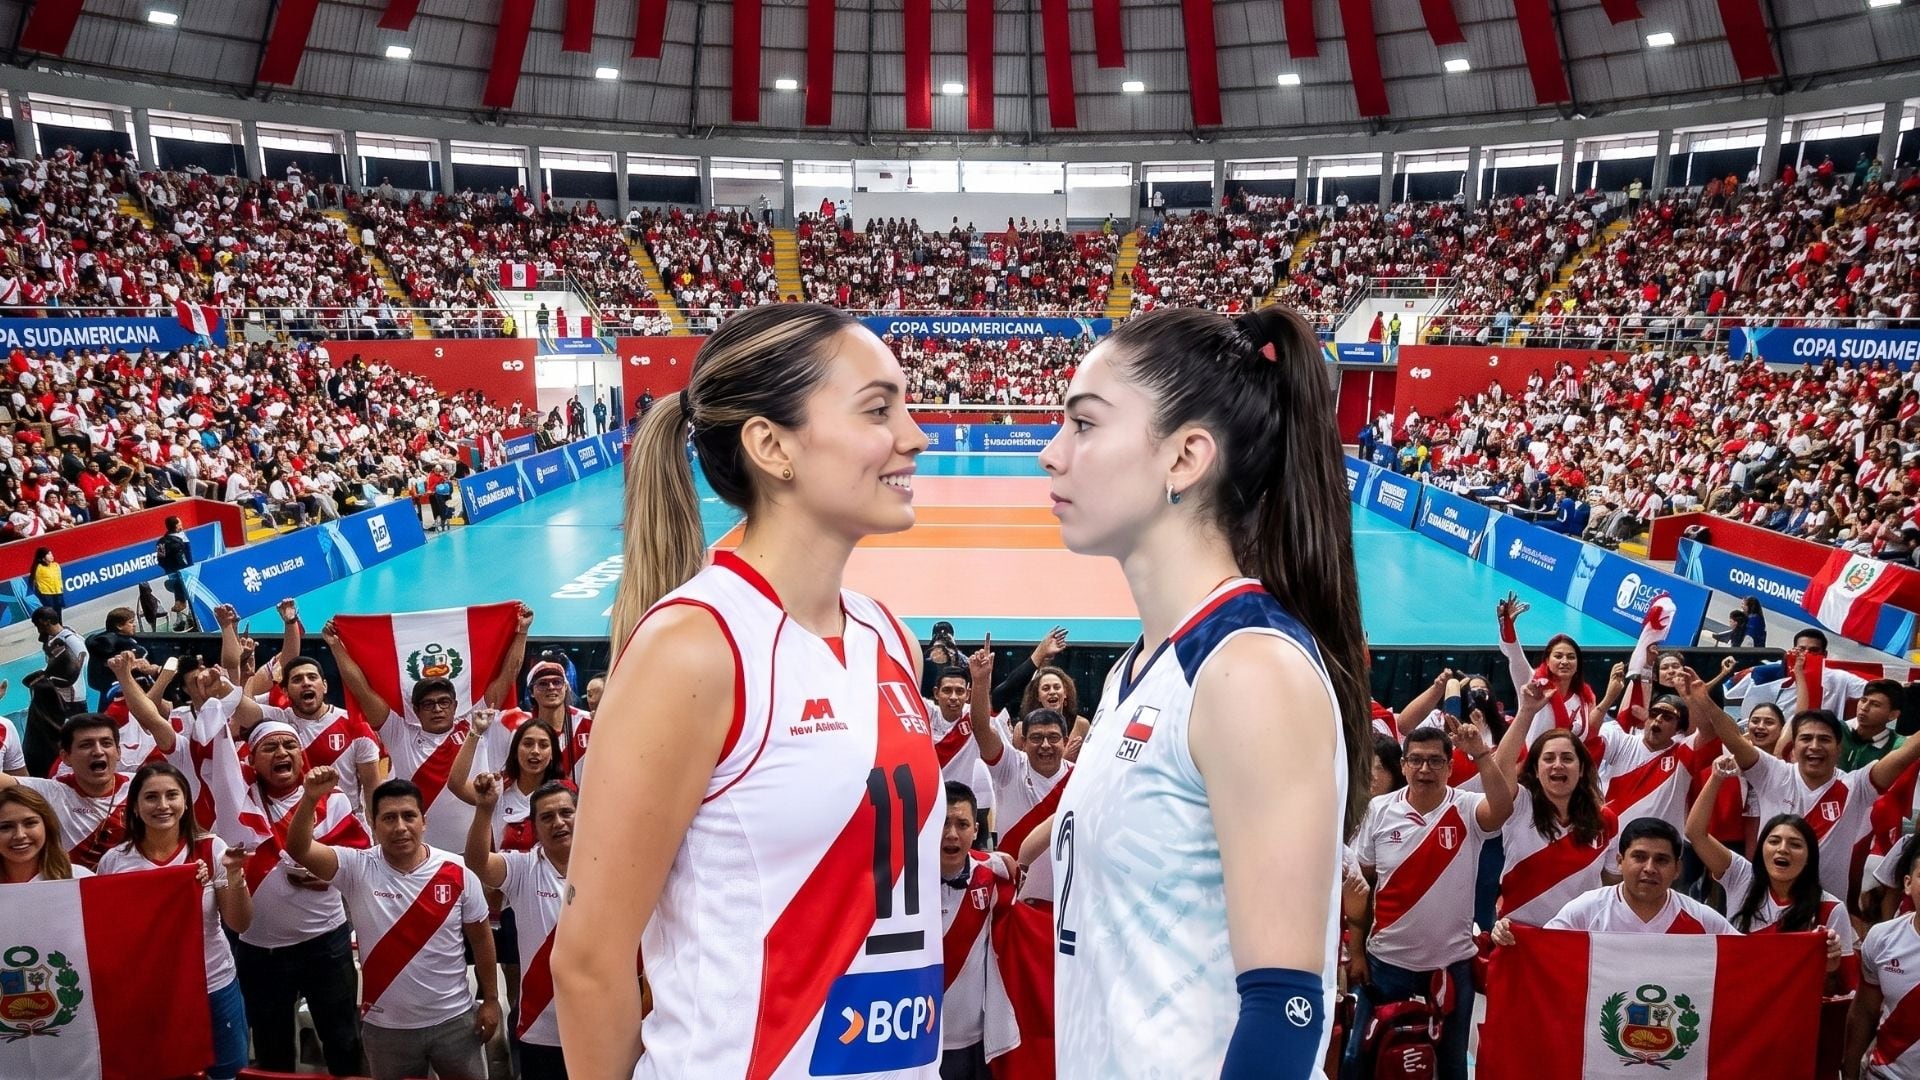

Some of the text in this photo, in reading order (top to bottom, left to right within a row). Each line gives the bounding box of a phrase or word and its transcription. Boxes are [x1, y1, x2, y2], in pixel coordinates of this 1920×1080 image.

[23, 326, 160, 347] SUDAMERICANA
[890, 321, 1044, 334] COPA SUDAMERICANA
[435, 348, 443, 358] 3
[1793, 338, 1836, 357] COPA
[1488, 356, 1498, 366] 3
[65, 570, 99, 592] COPA
[1729, 568, 1755, 589] COPA
[1117, 740, 1143, 760] CHI
[866, 763, 919, 919] 11
[866, 996, 926, 1043] BCP
